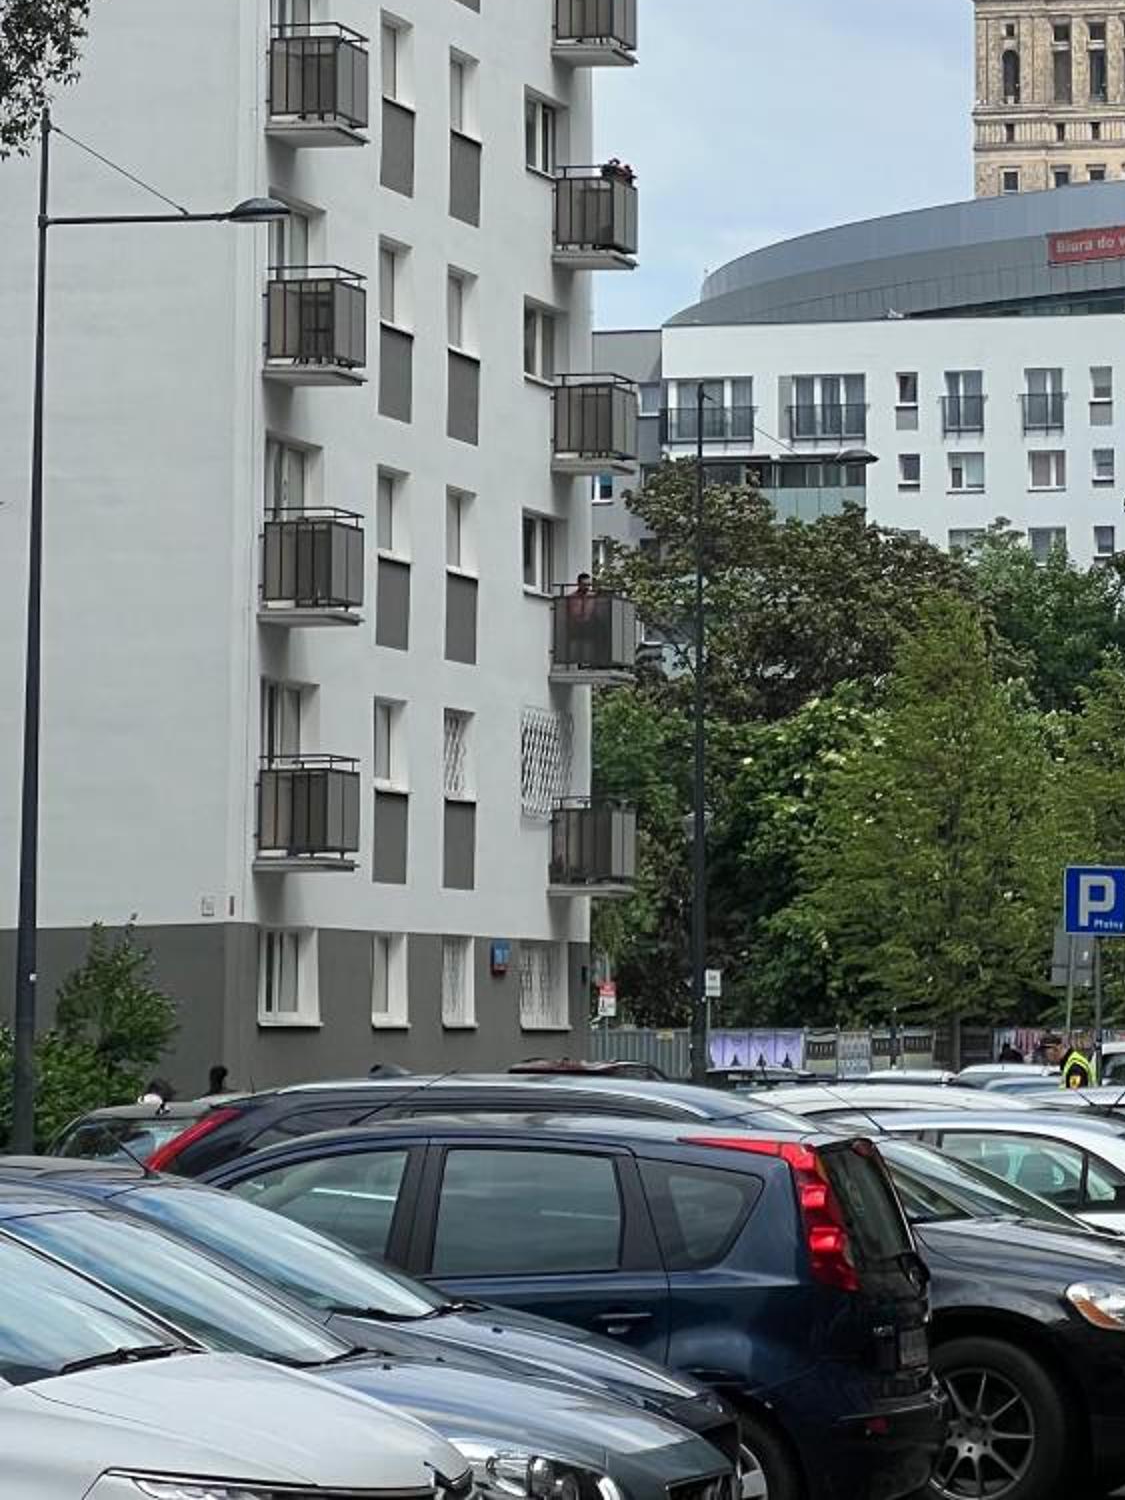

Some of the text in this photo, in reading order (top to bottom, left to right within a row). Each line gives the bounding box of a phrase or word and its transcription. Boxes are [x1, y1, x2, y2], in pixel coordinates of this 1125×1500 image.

[1056, 239, 1093, 253] Biura
[1098, 235, 1115, 249] do
[1078, 875, 1115, 926] P
